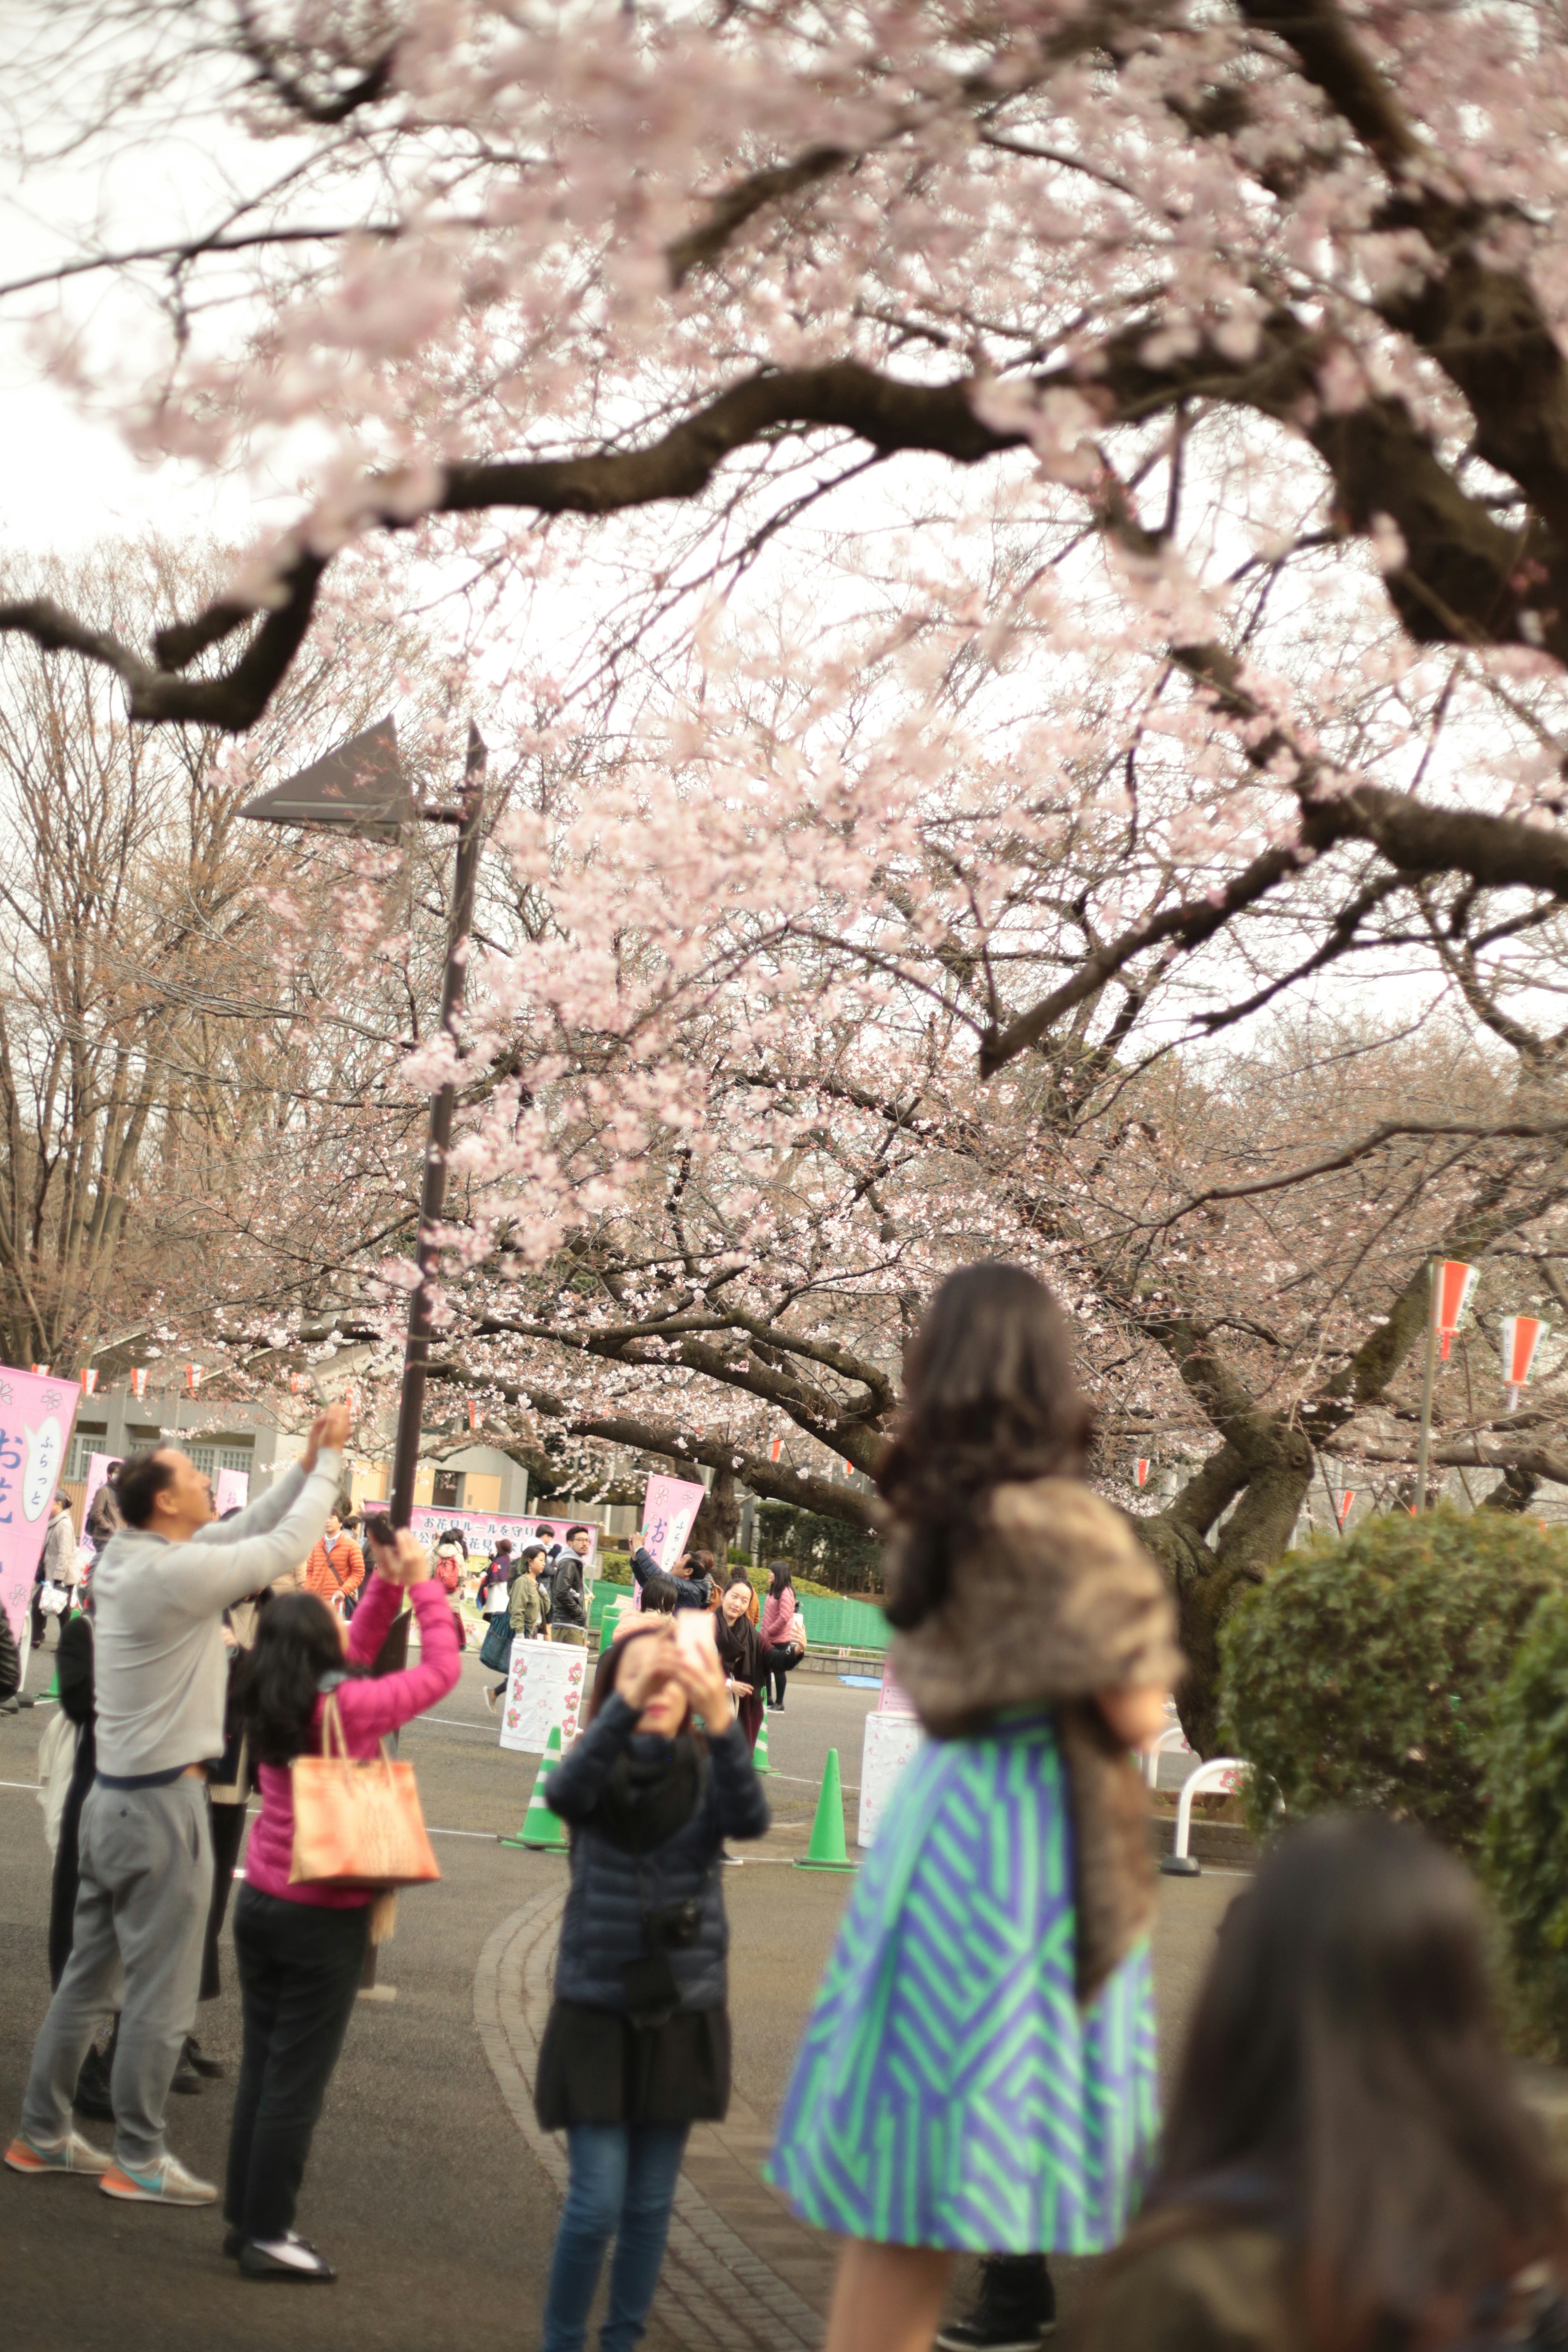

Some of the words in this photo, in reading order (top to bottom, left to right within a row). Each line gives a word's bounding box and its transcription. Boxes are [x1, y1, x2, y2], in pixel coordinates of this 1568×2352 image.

[31, 1437, 53, 1505] ふらっと
[665, 1521, 685, 1565] ふらっと
